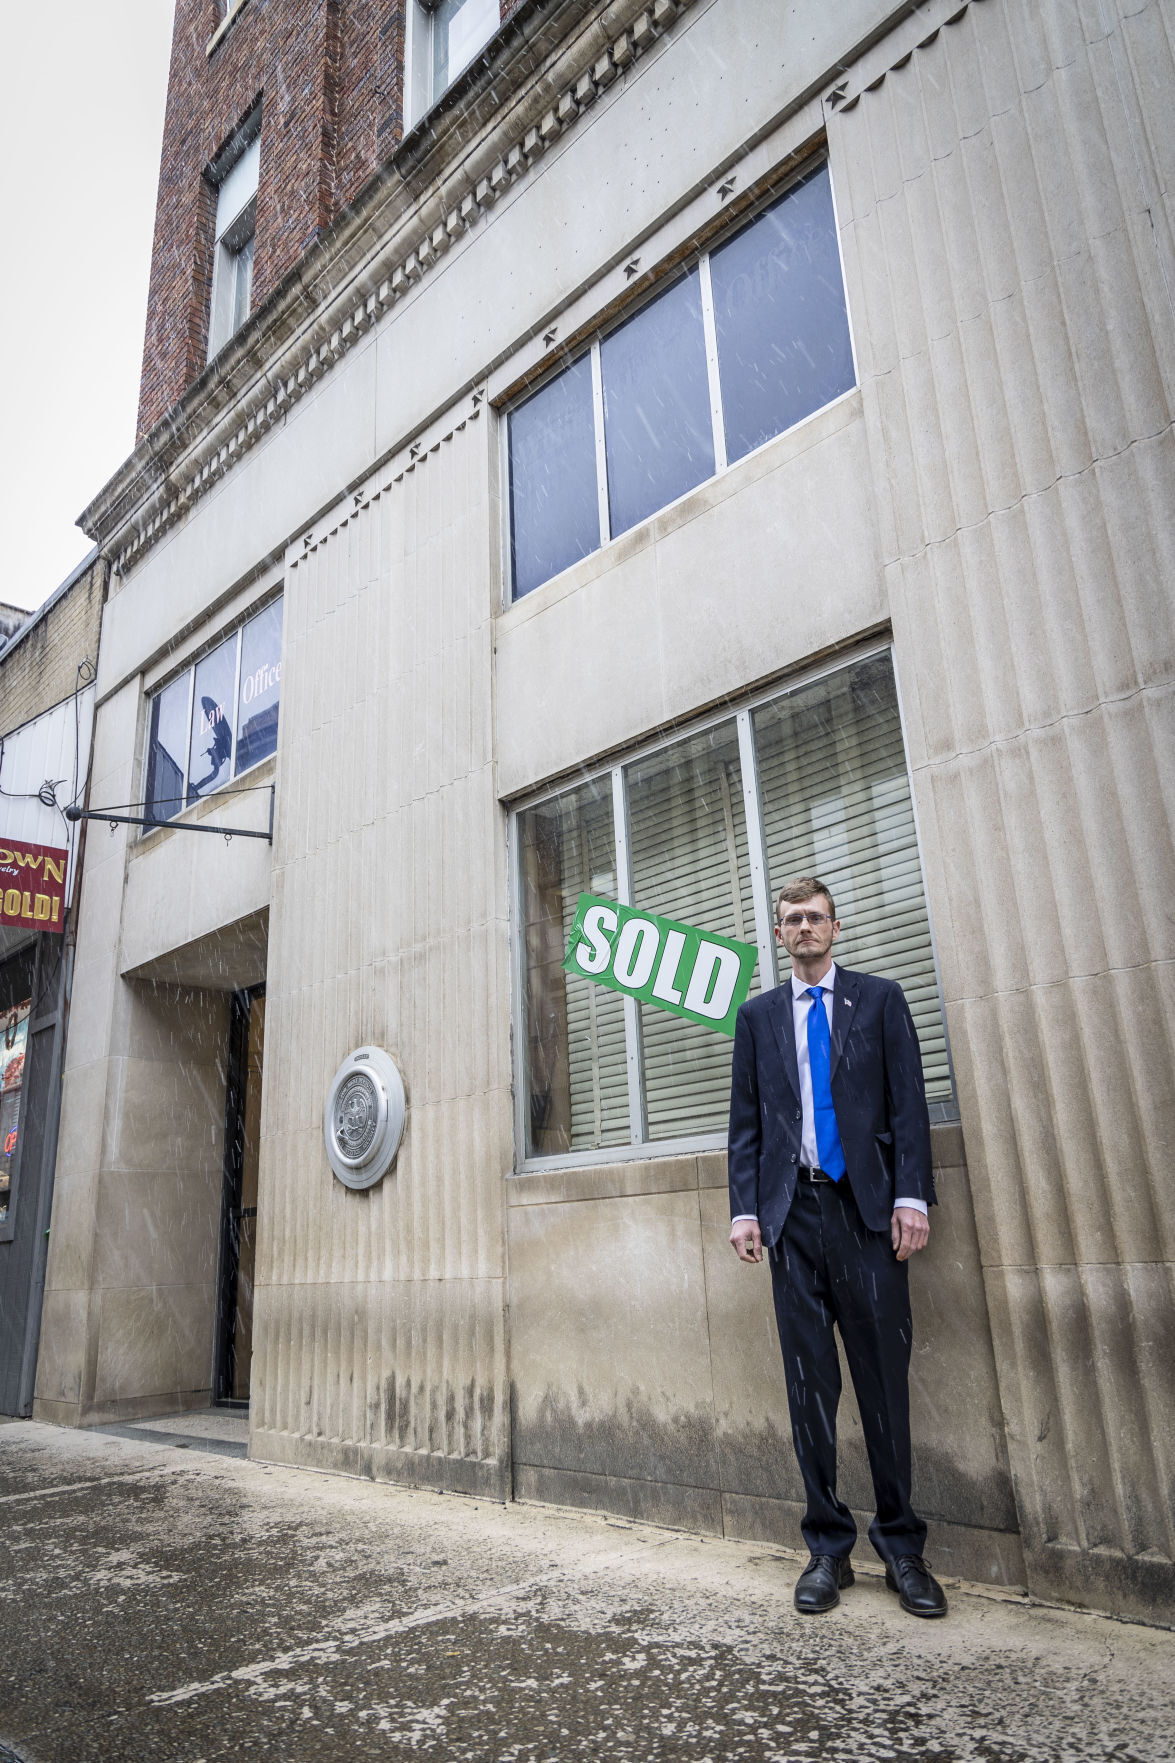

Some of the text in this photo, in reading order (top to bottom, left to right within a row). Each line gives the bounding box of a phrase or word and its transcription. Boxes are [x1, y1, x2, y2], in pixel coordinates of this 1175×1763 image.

[199, 701, 226, 736] Law
[0, 865, 19, 876] elry
[0, 888, 60, 922] OLD!
[575, 904, 741, 1021] SOLD
